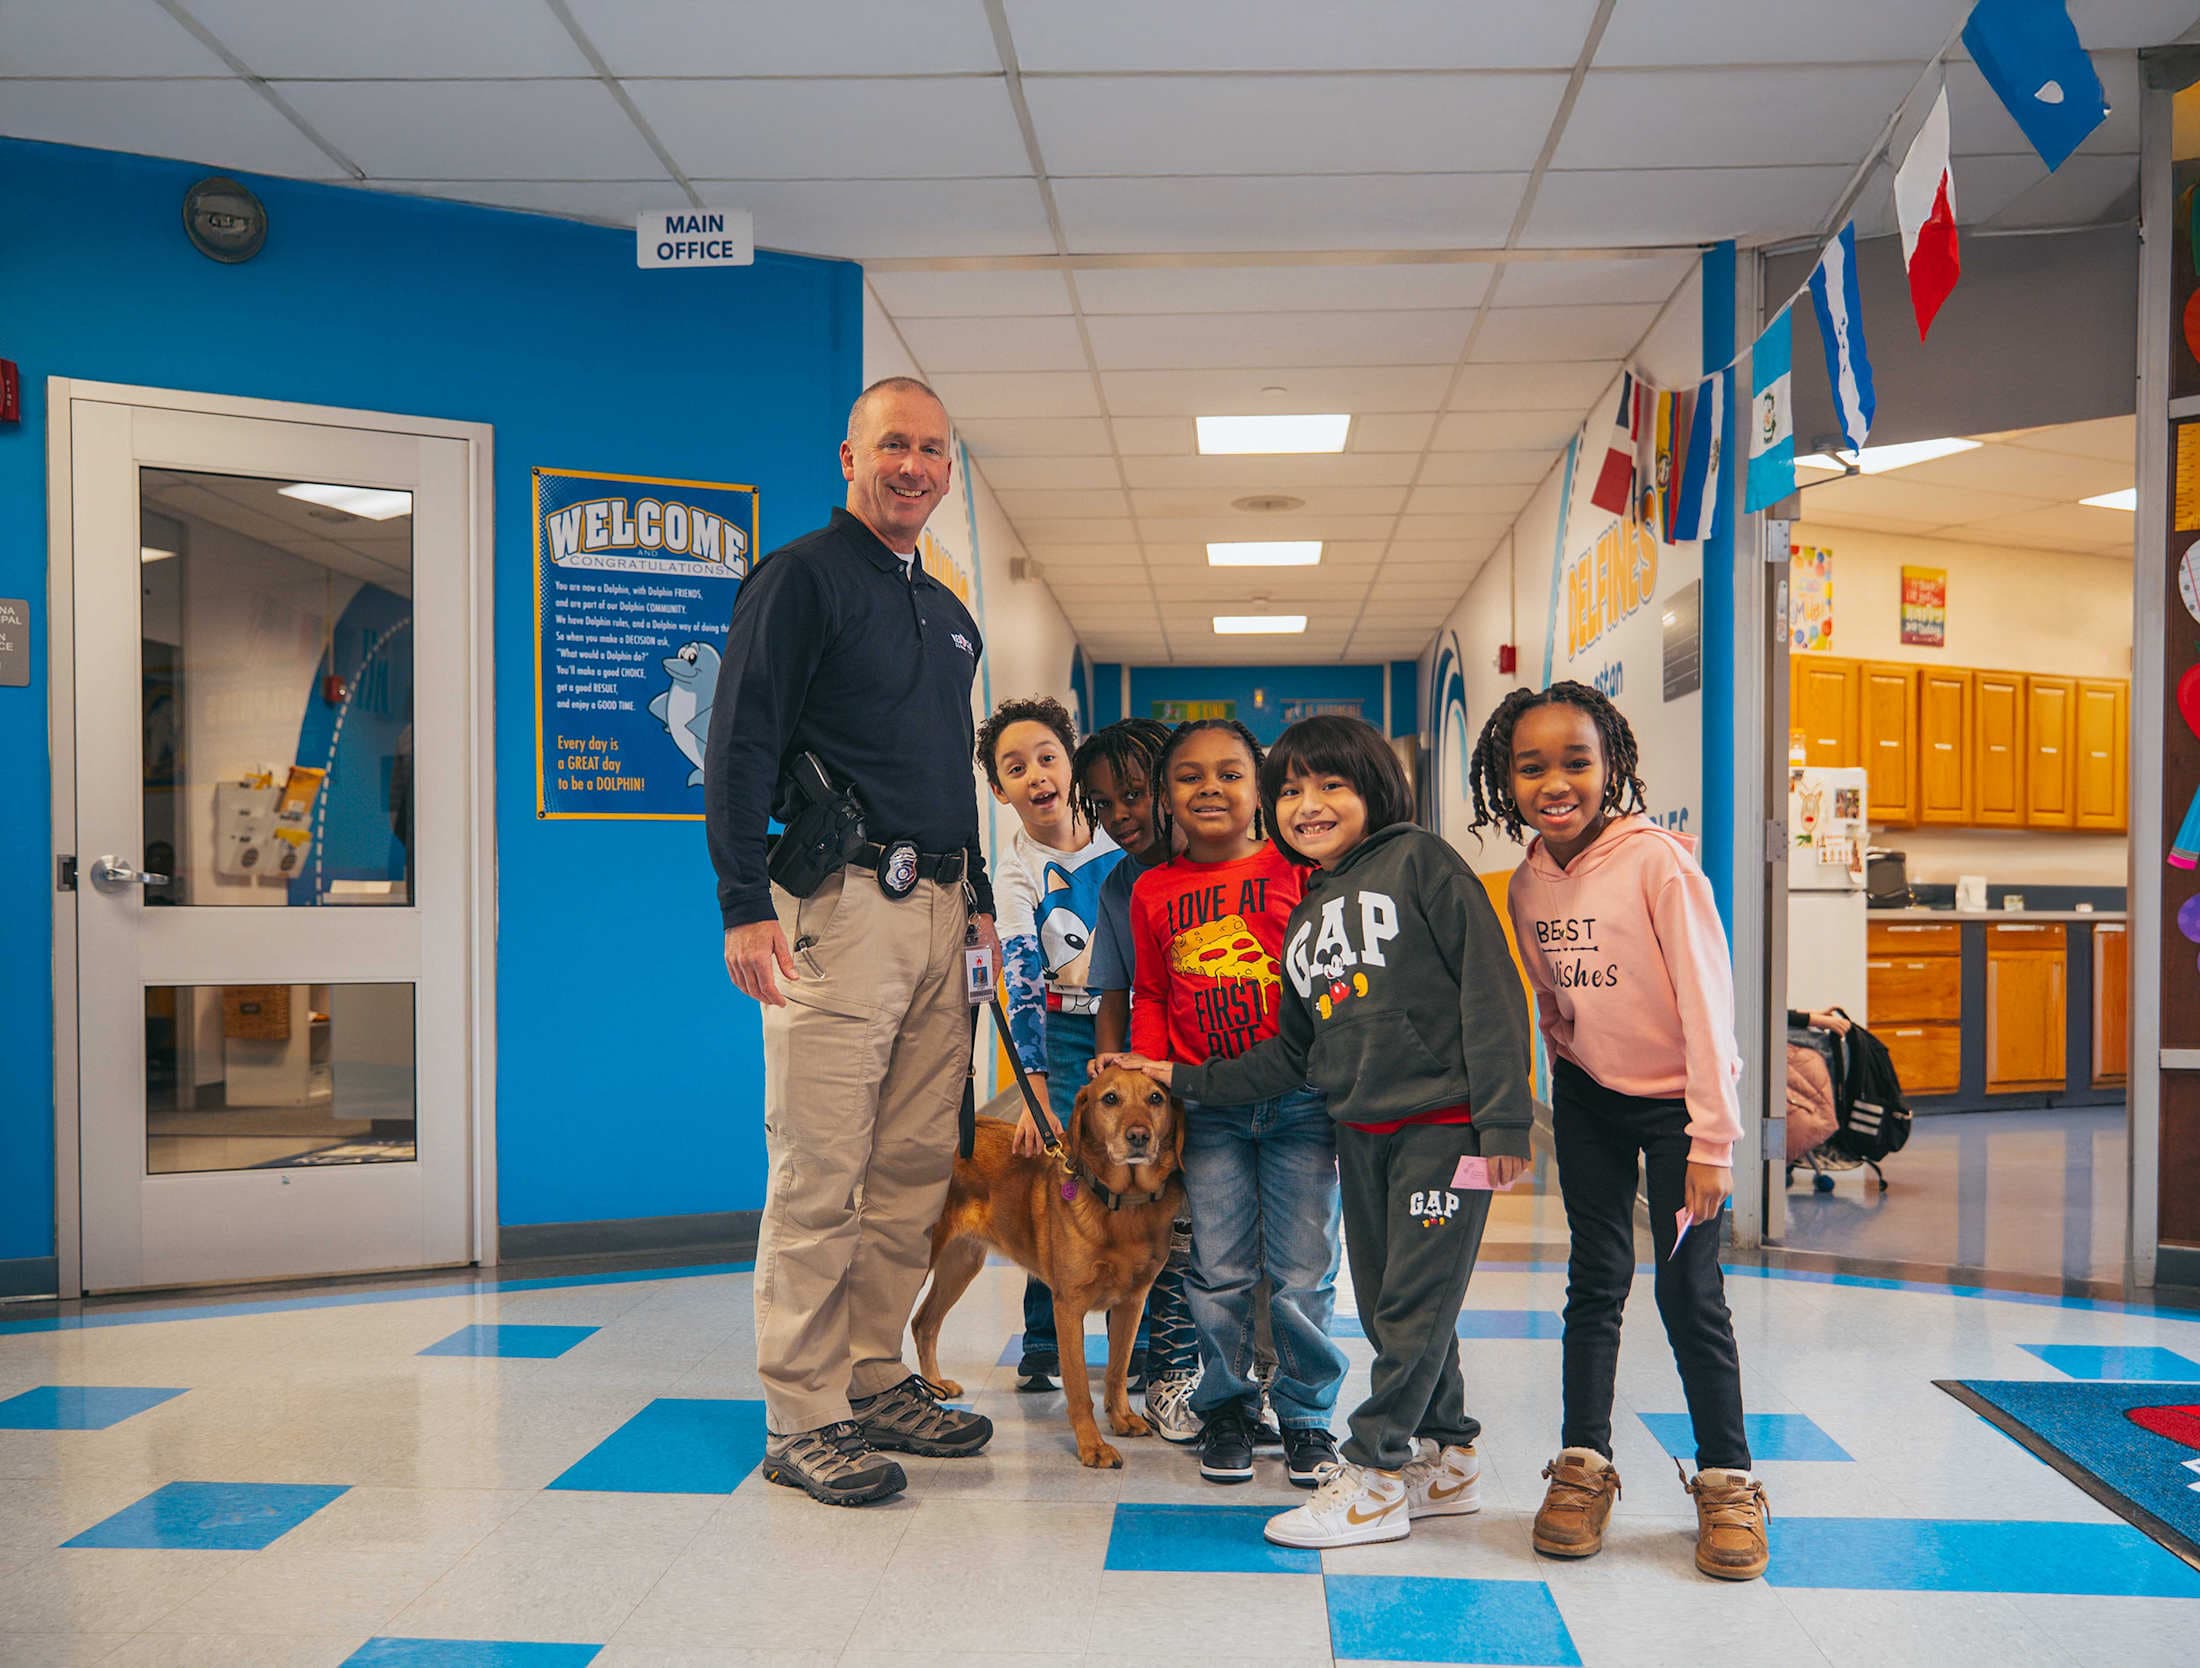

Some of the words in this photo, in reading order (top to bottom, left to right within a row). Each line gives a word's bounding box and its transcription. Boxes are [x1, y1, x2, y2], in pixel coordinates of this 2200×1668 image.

[666, 214, 724, 234] MAIN
[656, 240, 733, 260] OFFICE
[548, 499, 747, 578] WELCOME
[637, 549, 658, 557] AND
[555, 581, 568, 591] You
[569, 584, 580, 592] are
[582, 584, 595, 592] now
[603, 583, 631, 595] Dolphin,
[633, 585, 646, 595] with
[647, 586, 673, 597] Dolphin
[674, 588, 704, 600] FRIENDS,
[555, 598, 568, 607] and
[570, 600, 581, 608] are
[583, 600, 597, 610] part
[598, 600, 605, 609] of
[619, 601, 645, 612] Dolphin
[646, 603, 687, 614] COMMUNITY.
[555, 614, 566, 624] We
[567, 614, 583, 625] have
[585, 616, 611, 627] Dolphin
[613, 617, 631, 629] rules,
[632, 619, 644, 628] and
[652, 620, 677, 631] Dolphin
[679, 623, 692, 633] way
[693, 622, 700, 631] of
[701, 623, 719, 635] doing
[556, 631, 565, 641] So
[566, 631, 584, 642] when
[585, 635, 598, 644] you
[599, 633, 618, 644] make
[625, 635, 656, 646] DECISION
[657, 636, 671, 647] ask,
[580, 648, 599, 660] would
[606, 650, 632, 662] Dolphin
[556, 665, 576, 676] You'll
[577, 666, 596, 677] make
[603, 667, 620, 679] good
[621, 668, 647, 679] CHOICE,
[556, 684, 568, 694] get
[575, 682, 592, 695] good
[593, 683, 619, 695] RESULT,
[556, 699, 570, 709] and
[571, 699, 590, 712] enjoy
[597, 700, 617, 710] GOOD
[618, 700, 636, 711] TIME.
[557, 735, 586, 753] Every
[588, 735, 608, 753] day
[610, 737, 619, 751] is
[557, 759, 565, 770] a
[567, 755, 600, 770] GREAT
[602, 755, 621, 774] day
[558, 777, 568, 790] to
[571, 775, 584, 790] be
[587, 780, 593, 790] a
[596, 776, 645, 792] DOLPHIN!
[1167, 884, 1227, 935] LOVE
[1238, 878, 1270, 915] AT
[1536, 918, 1596, 943] BEST
[1285, 890, 1400, 998] GAP
[1194, 980, 1263, 1033] FIRST
[1409, 1190, 1460, 1218] GAP
